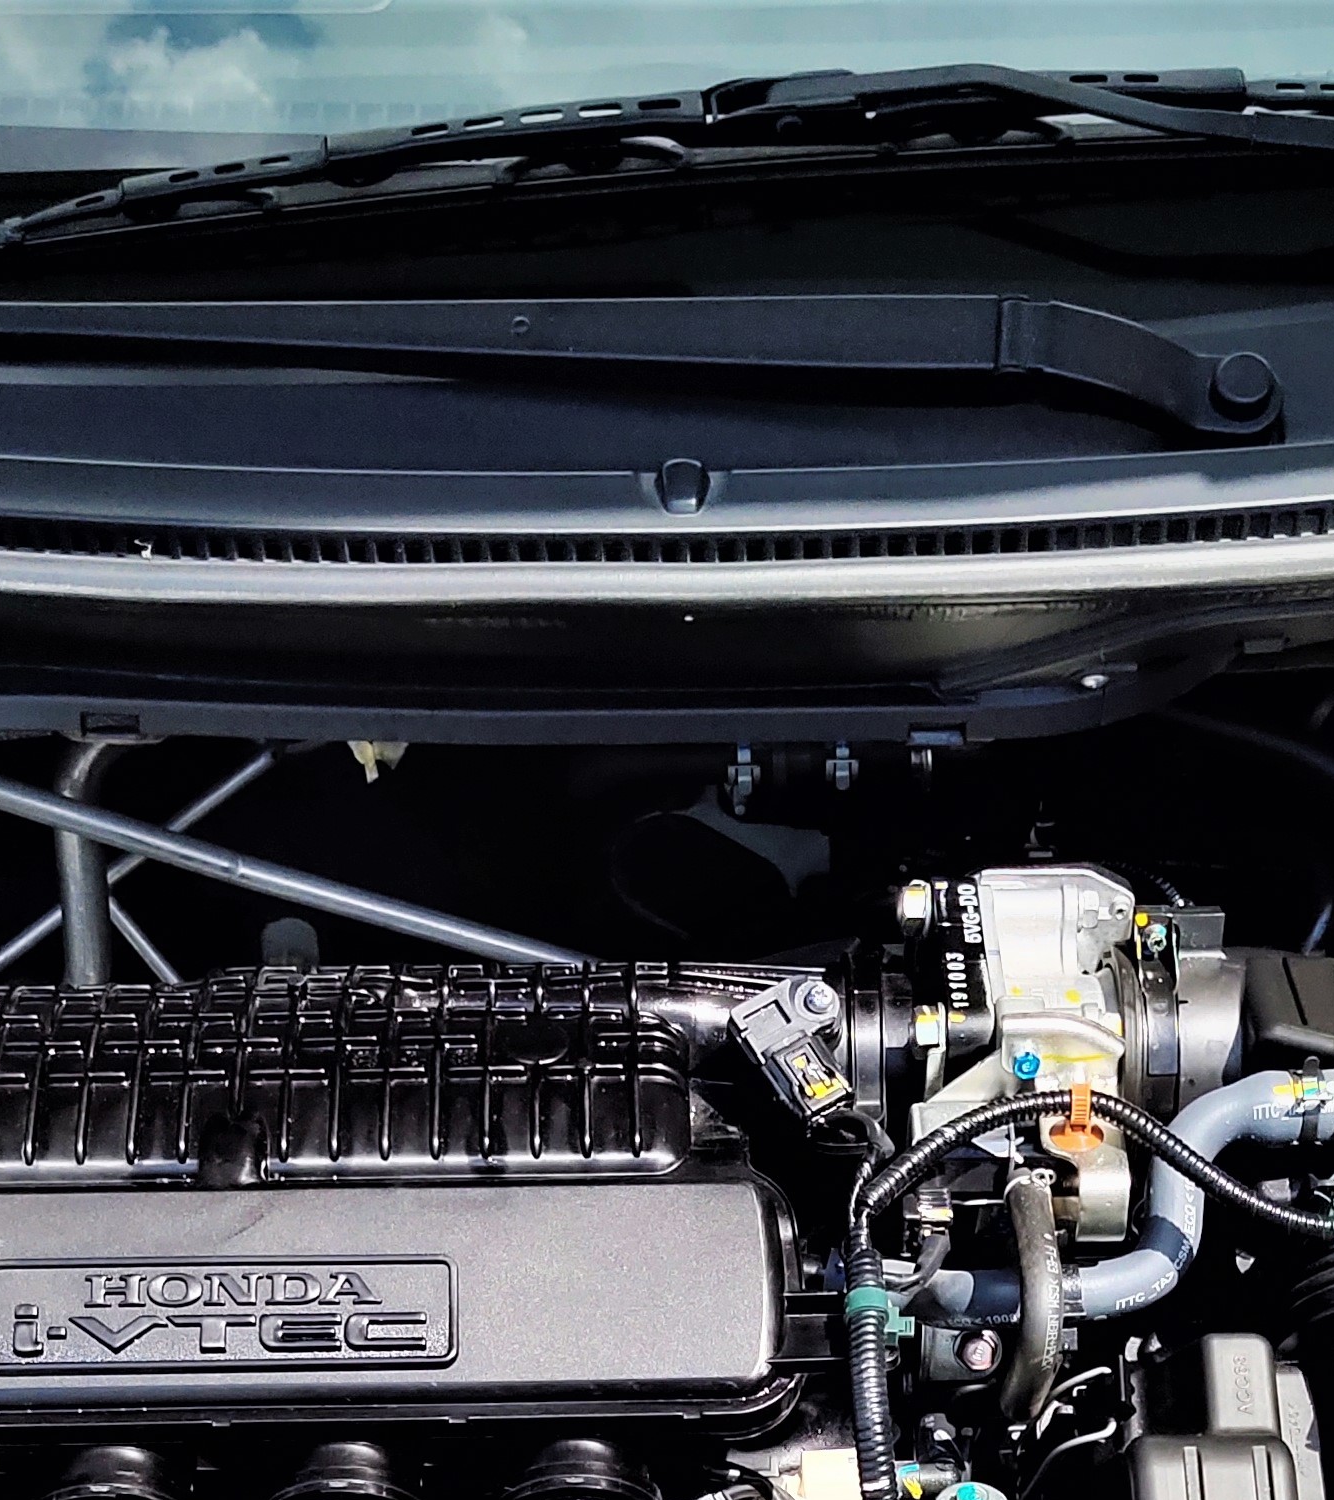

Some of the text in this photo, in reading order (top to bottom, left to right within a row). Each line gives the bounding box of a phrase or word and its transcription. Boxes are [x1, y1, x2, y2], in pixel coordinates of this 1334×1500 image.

[945, 952, 970, 1009] 191003
[83, 1272, 383, 1309] HONDA
[12, 1303, 428, 1358] i-VTEC
